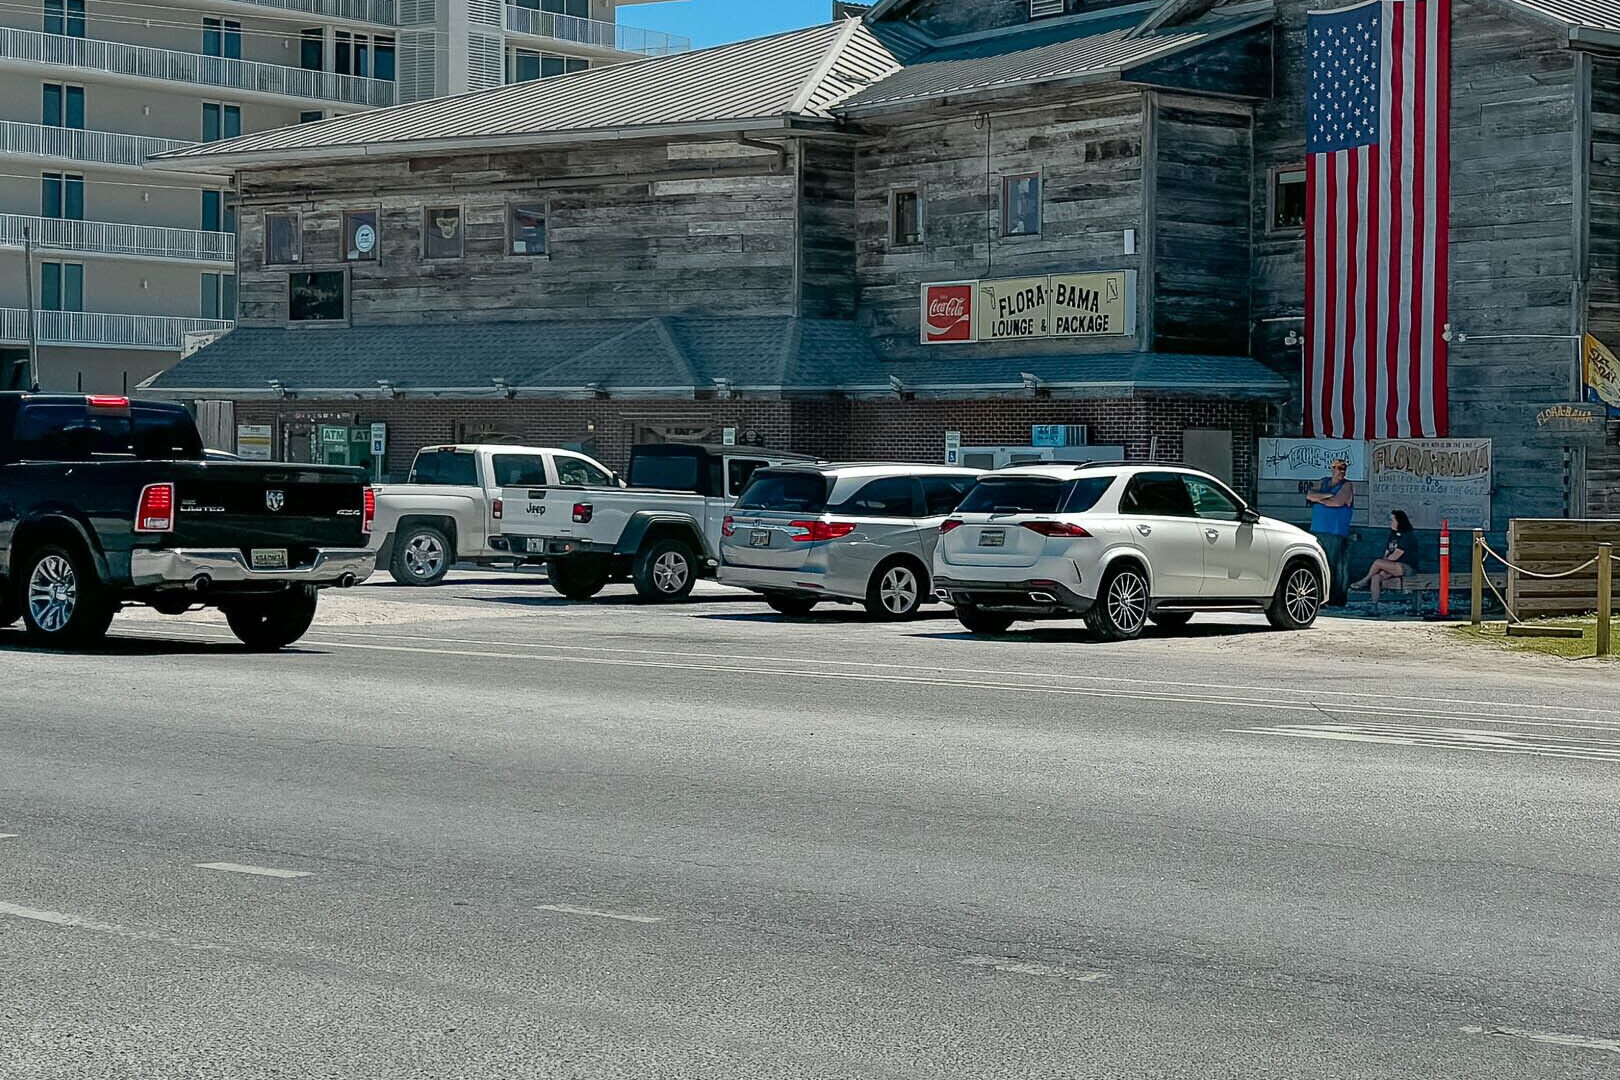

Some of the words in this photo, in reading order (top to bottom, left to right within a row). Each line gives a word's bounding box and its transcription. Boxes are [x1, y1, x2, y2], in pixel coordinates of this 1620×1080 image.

[992, 319, 1033, 337] LOUNGE
[1041, 319, 1047, 332] &
[1056, 315, 1109, 334] PACKAGE
[324, 430, 345, 441] ATM
[355, 431, 371, 441] AT
